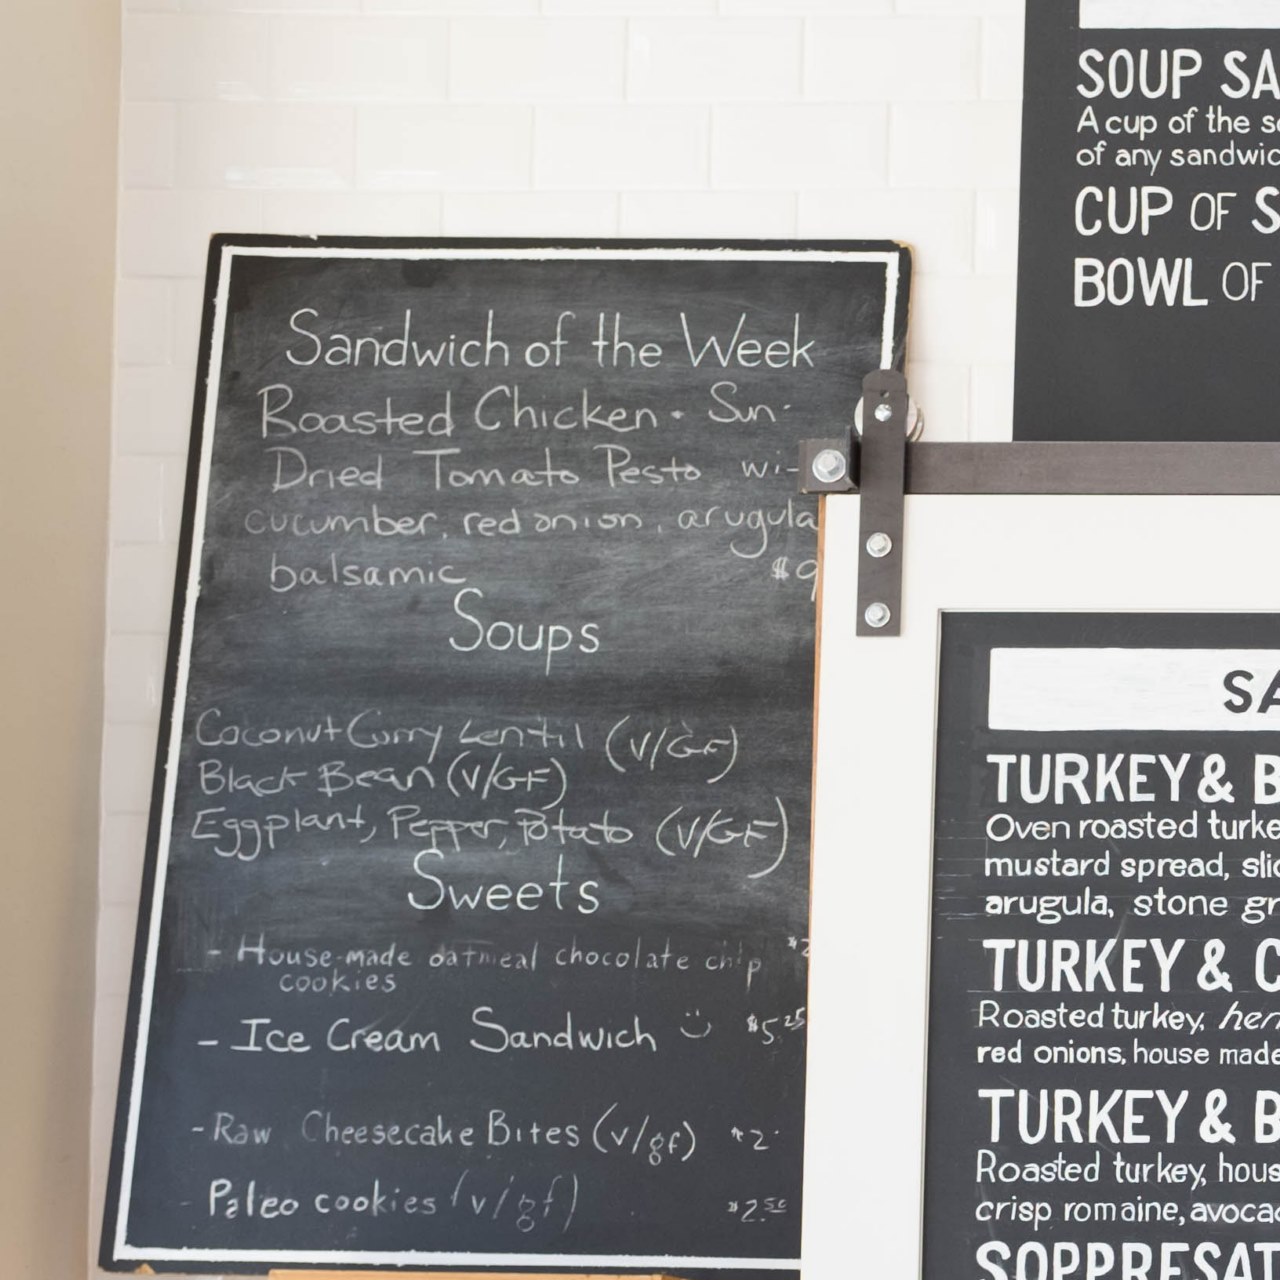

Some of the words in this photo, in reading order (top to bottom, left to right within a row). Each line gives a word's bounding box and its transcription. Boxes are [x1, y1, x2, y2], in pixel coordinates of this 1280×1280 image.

[1077, 49, 1202, 99] SOUP
[1075, 186, 1173, 235] CUP
[1191, 193, 1236, 231] OF
[286, 308, 509, 367] Sandwich
[525, 311, 575, 367] of
[592, 312, 662, 367] the
[680, 313, 814, 368] Week
[258, 384, 454, 438] Roasted
[475, 385, 657, 432] Chicken
[449, 587, 599, 675] Soups
[987, 753, 1190, 804] TURKEY
[1198, 754, 1234, 802] &
[408, 848, 599, 913] Sweets
[985, 849, 1109, 876] mustard
[1121, 852, 1229, 882] spread,
[983, 938, 1185, 992] TURKEY
[1197, 939, 1232, 992] &
[231, 1019, 310, 1052] Ice
[327, 1018, 440, 1053] Cream
[470, 1006, 656, 1052] Sandwich
[978, 1039, 1021, 1063] red
[1034, 1039, 1126, 1065] onions,
[1134, 1038, 1209, 1064] house
[978, 1089, 1188, 1144] TURKEY
[1199, 1089, 1235, 1143] &
